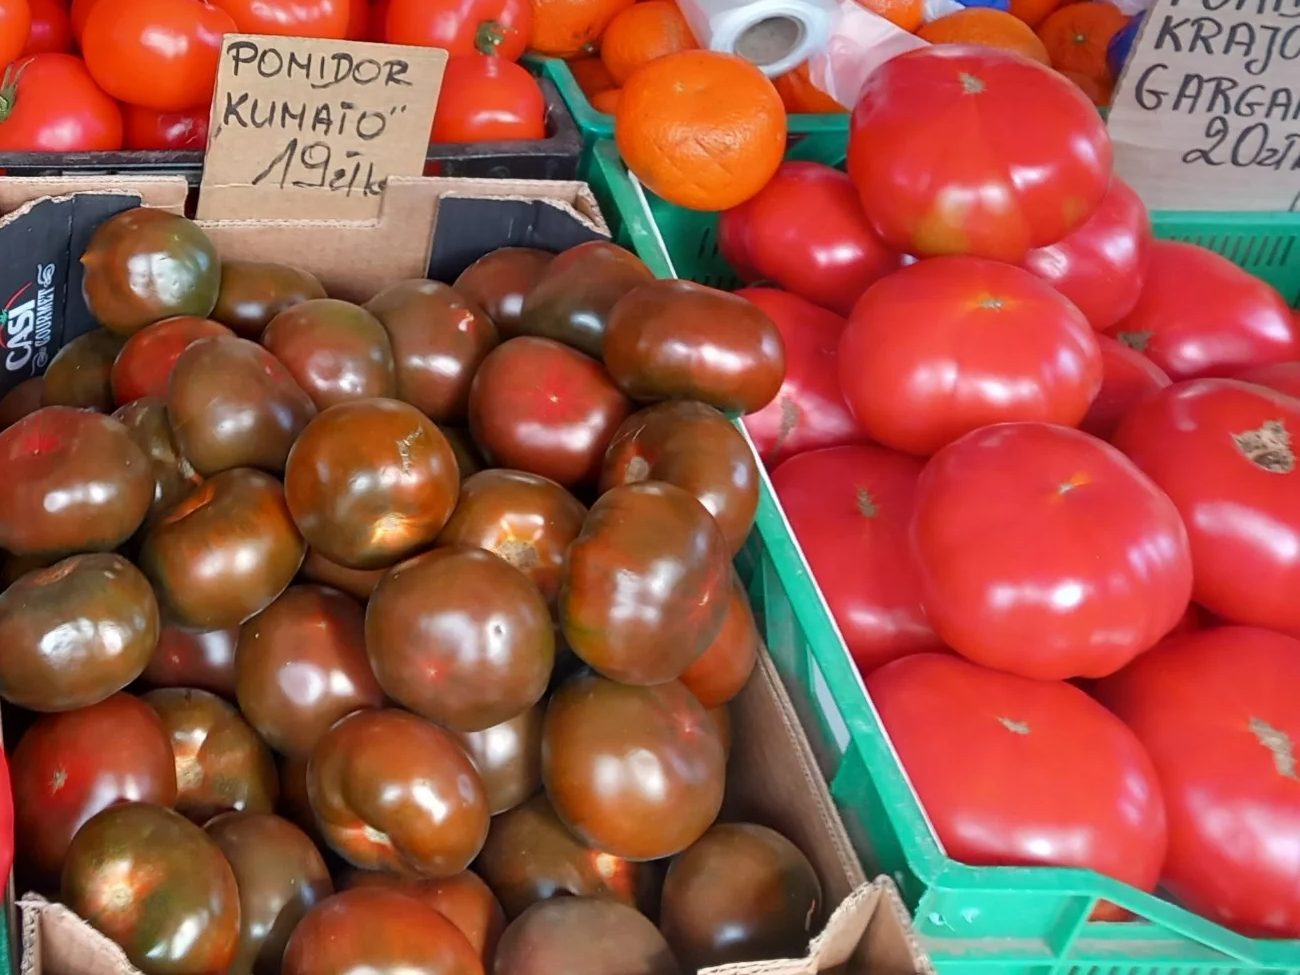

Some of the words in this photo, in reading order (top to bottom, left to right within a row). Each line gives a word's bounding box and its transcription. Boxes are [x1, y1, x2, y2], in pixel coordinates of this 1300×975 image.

[226, 40, 413, 89] POMIDOR
[5, 299, 36, 372] CASI
[35, 286, 55, 347] GOURMET
